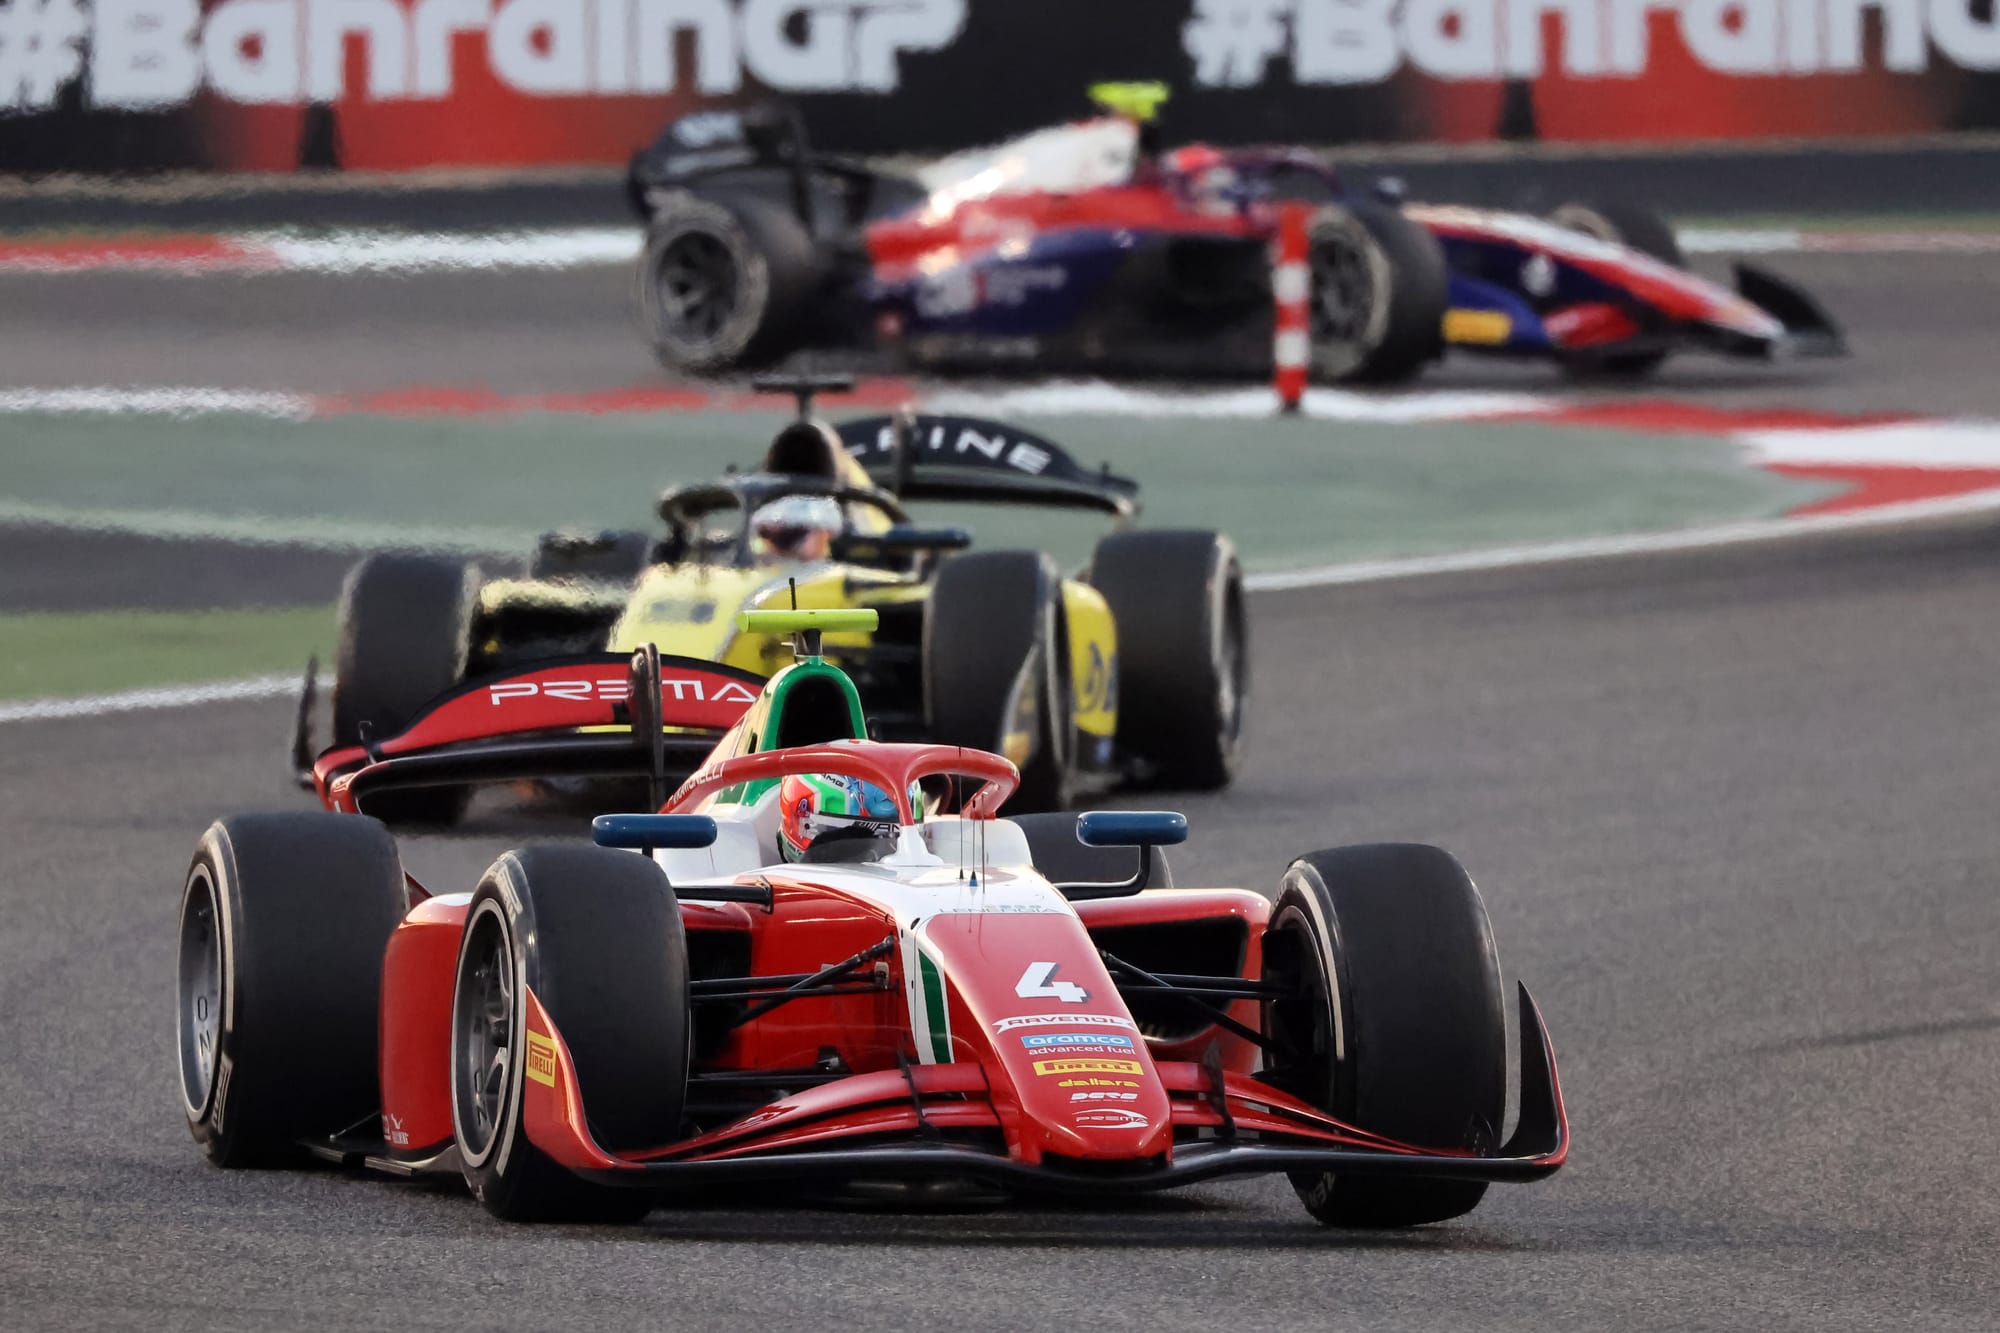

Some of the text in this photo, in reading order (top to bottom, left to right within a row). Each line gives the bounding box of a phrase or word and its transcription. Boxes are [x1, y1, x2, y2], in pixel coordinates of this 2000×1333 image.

[489, 679, 758, 705] PREMA
[1014, 962, 1089, 1003] 4
[1007, 1016, 1121, 1026] RAVENOL
[1029, 1034, 1126, 1045] aramco
[1028, 1046, 1137, 1055] advanced fuel
[529, 1040, 554, 1077] PIRELLI
[1043, 1061, 1134, 1072] PIRELLI
[1057, 1078, 1140, 1087] dallara
